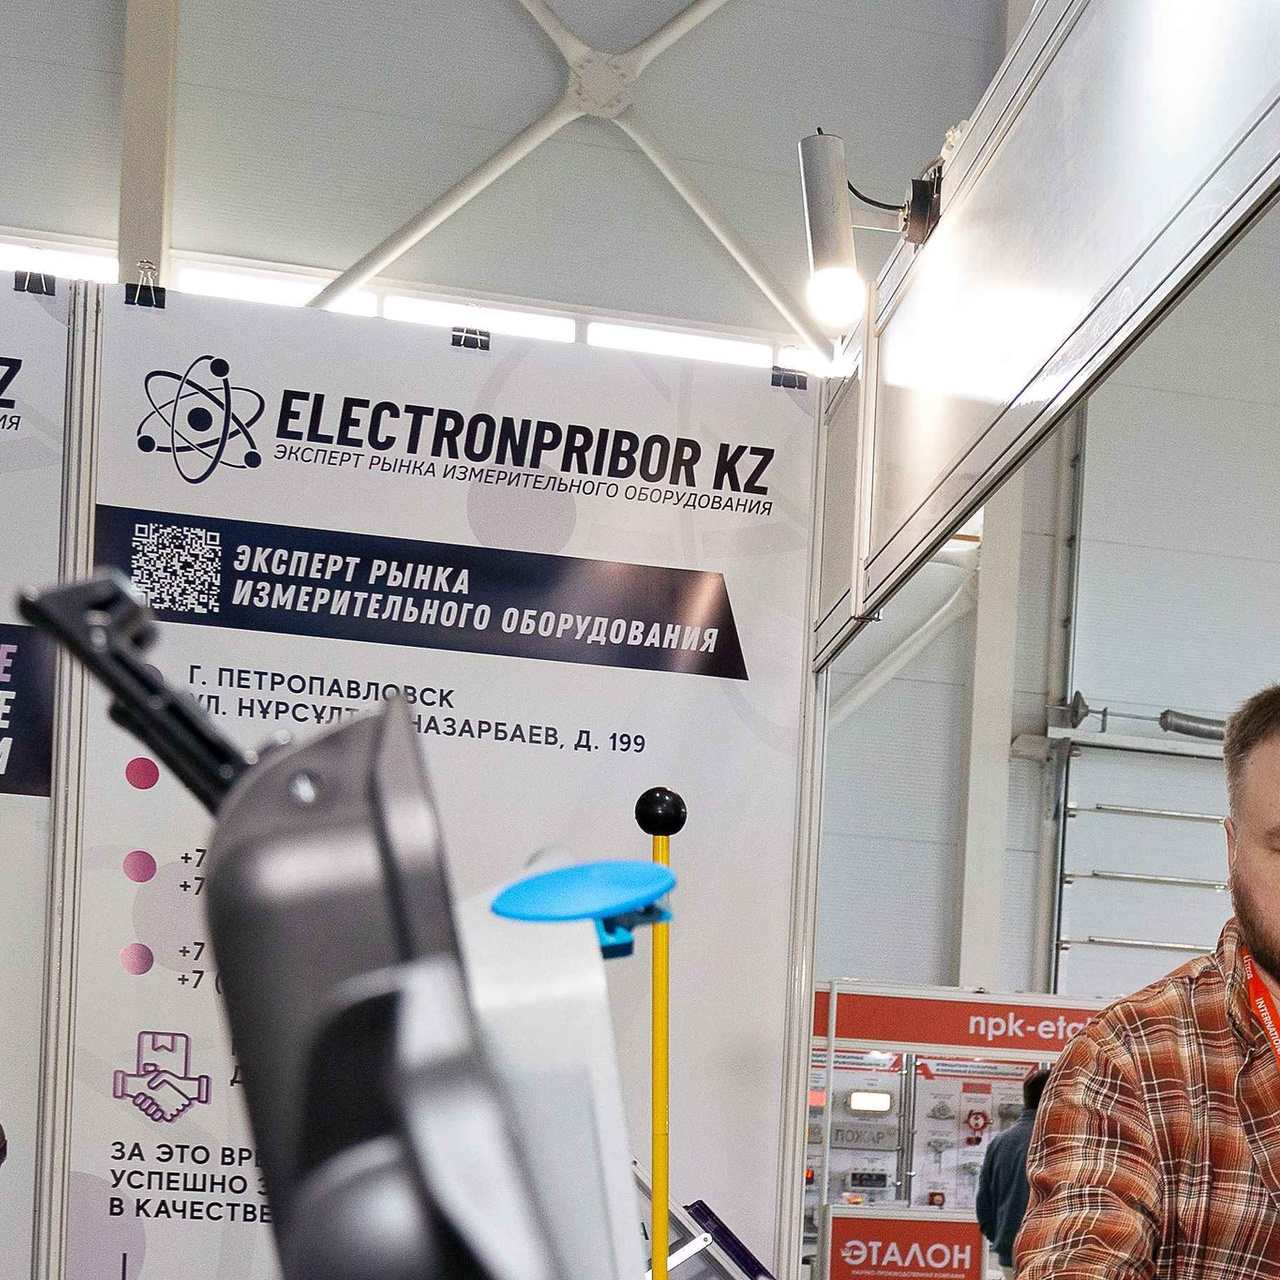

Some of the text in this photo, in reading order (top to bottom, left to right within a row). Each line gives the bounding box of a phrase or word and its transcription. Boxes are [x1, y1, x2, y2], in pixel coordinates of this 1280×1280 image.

[276, 389, 775, 495] ELECTRONPRIBOR KZ
[274, 444, 773, 516] ЭКСПЕРТ РЫНКА ИЗМЕРИТЕЛЬНОГО ОБОРУДОВАНИЯ
[233, 544, 470, 594] ЭКСПЕРТ РЫНКА
[232, 579, 719, 653] ИЗМЕРИТЕЛЬНОГО ОБОРУДОВАНИЯ
[189, 664, 455, 708] Г. ПЕТРОПАВЛОВСК
[574, 730, 599, 751] Д.
[609, 732, 646, 753] 199
[181, 849, 207, 867] +7
[179, 877, 205, 895] +7
[179, 942, 205, 961] +7
[178, 970, 204, 989] +7
[968, 1012, 1095, 1041] npk-eta
[110, 1141, 145, 1161] ЗА
[155, 1143, 210, 1164] ЭТО
[110, 1169, 248, 1195] УСПЕШНО
[109, 1197, 272, 1223] В КАЧЕСТВЕ
[843, 1240, 971, 1269] ЭТАЛОН
